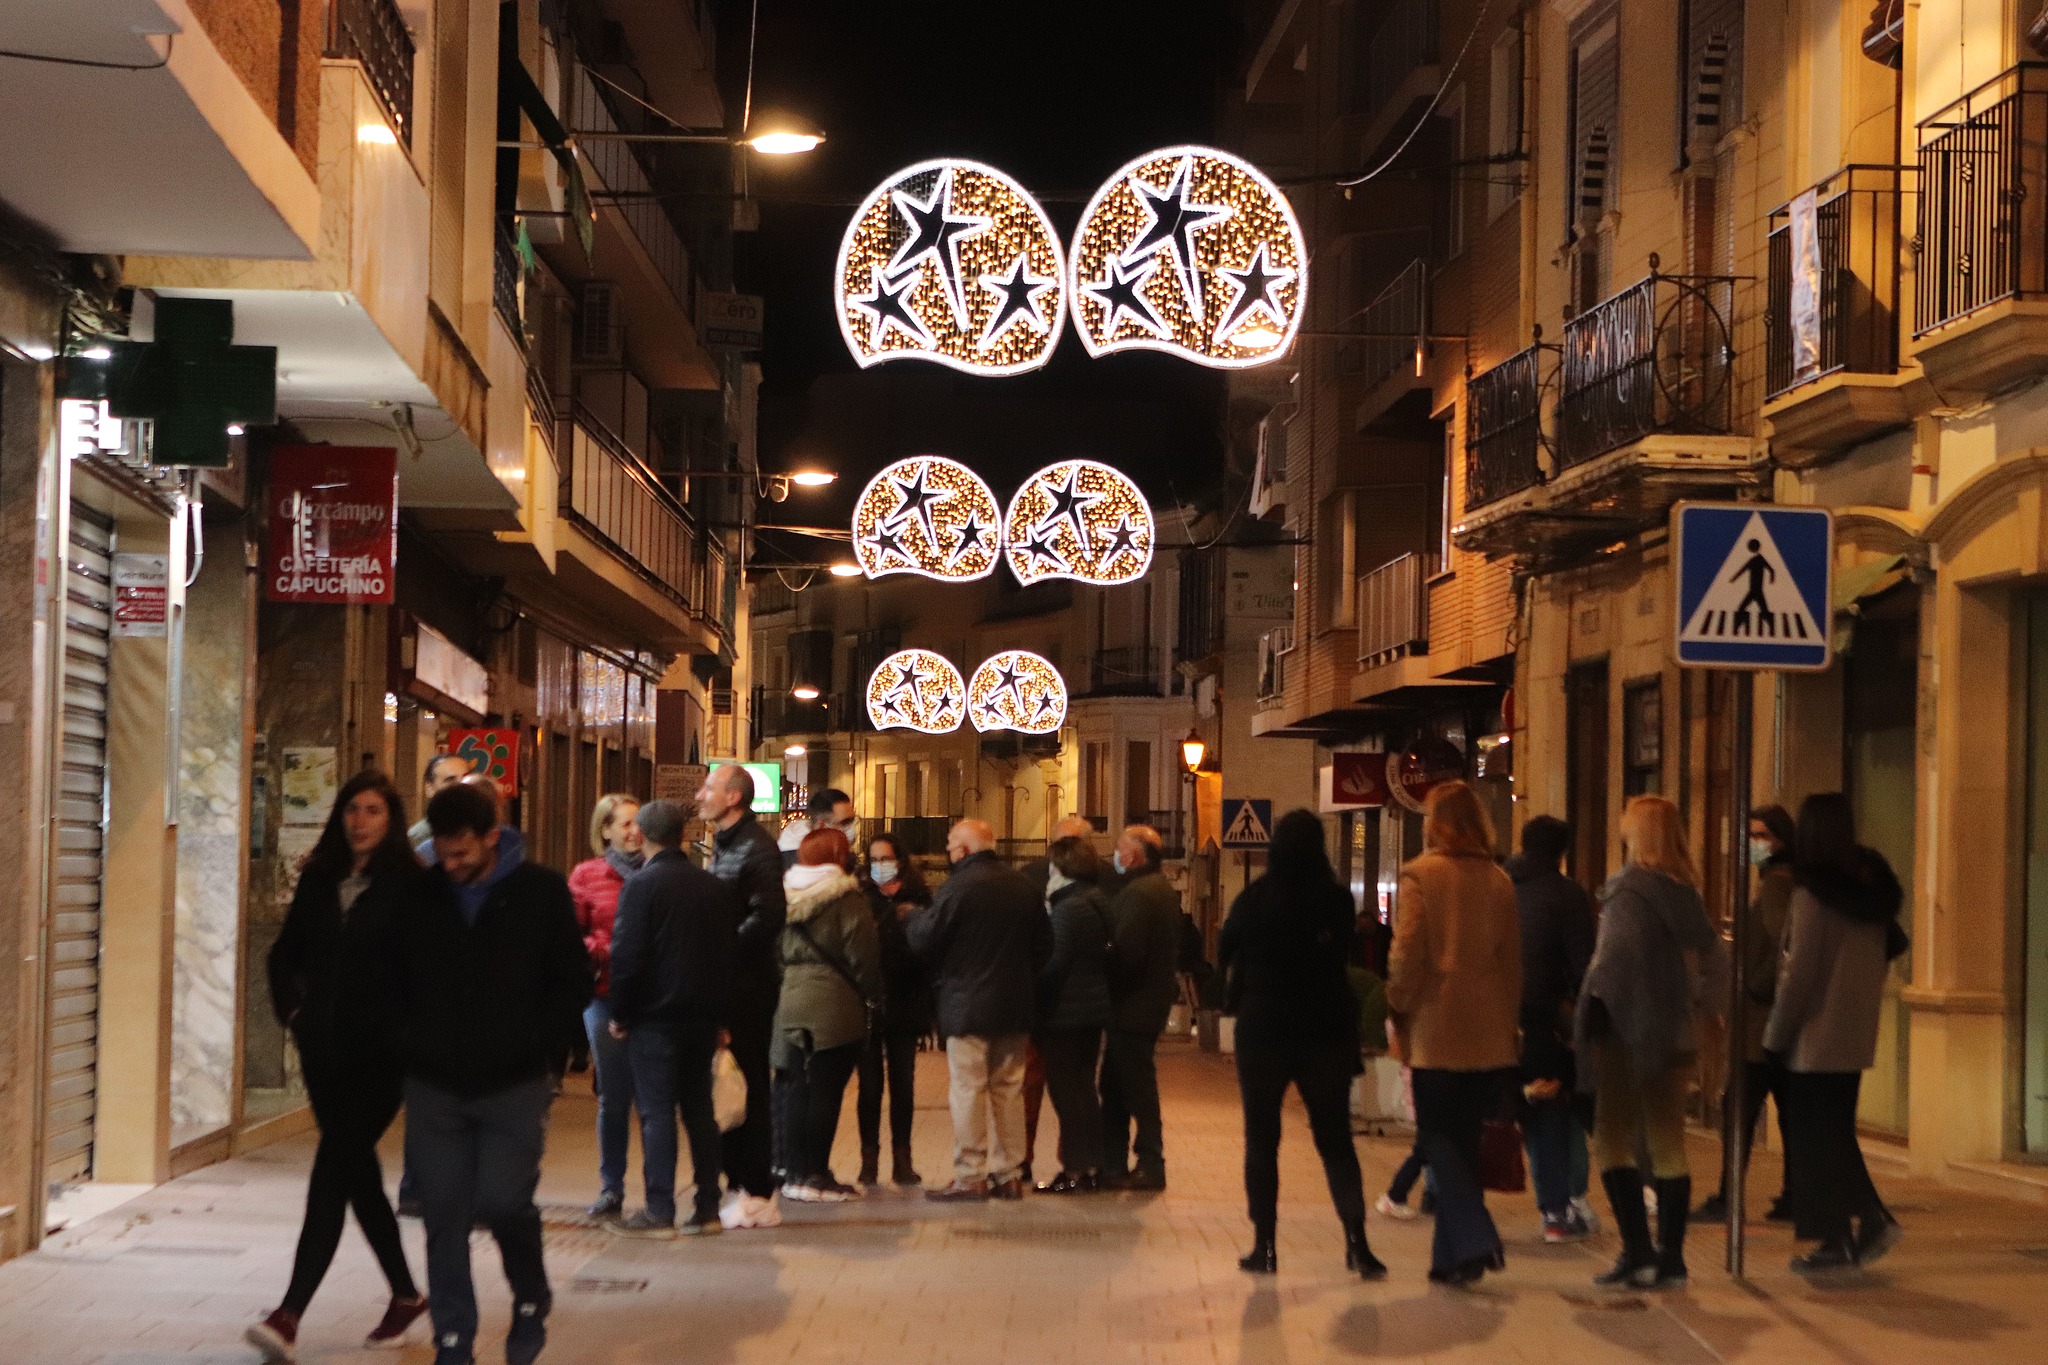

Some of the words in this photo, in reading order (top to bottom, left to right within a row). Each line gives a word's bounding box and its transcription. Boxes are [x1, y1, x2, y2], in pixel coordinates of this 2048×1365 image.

[280, 497, 386, 525] Czcampo
[279, 554, 383, 575] CAFETERÍA
[275, 576, 385, 596] CAPUCHINO
